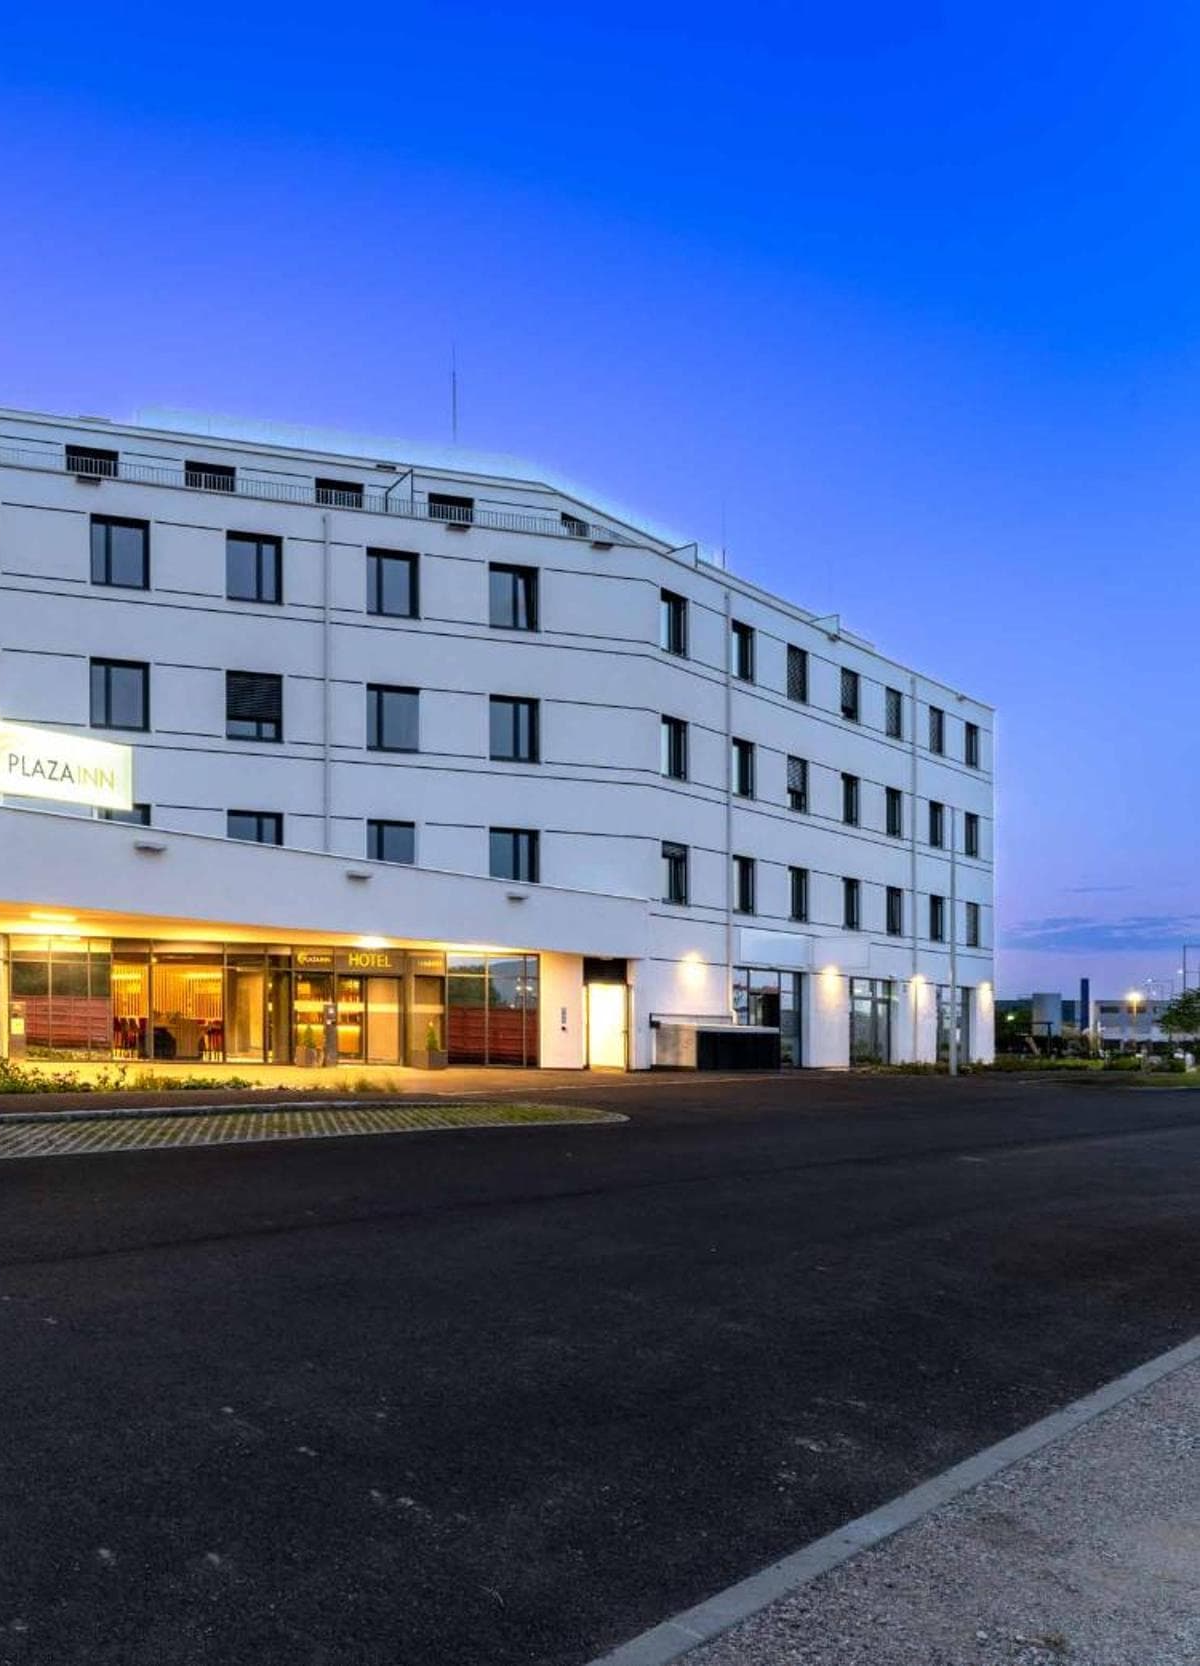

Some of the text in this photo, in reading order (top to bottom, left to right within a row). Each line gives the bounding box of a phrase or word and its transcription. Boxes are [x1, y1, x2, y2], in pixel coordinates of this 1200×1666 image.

[8, 753, 116, 791] PLAZA INN
[348, 952, 392, 968] HOTEL
